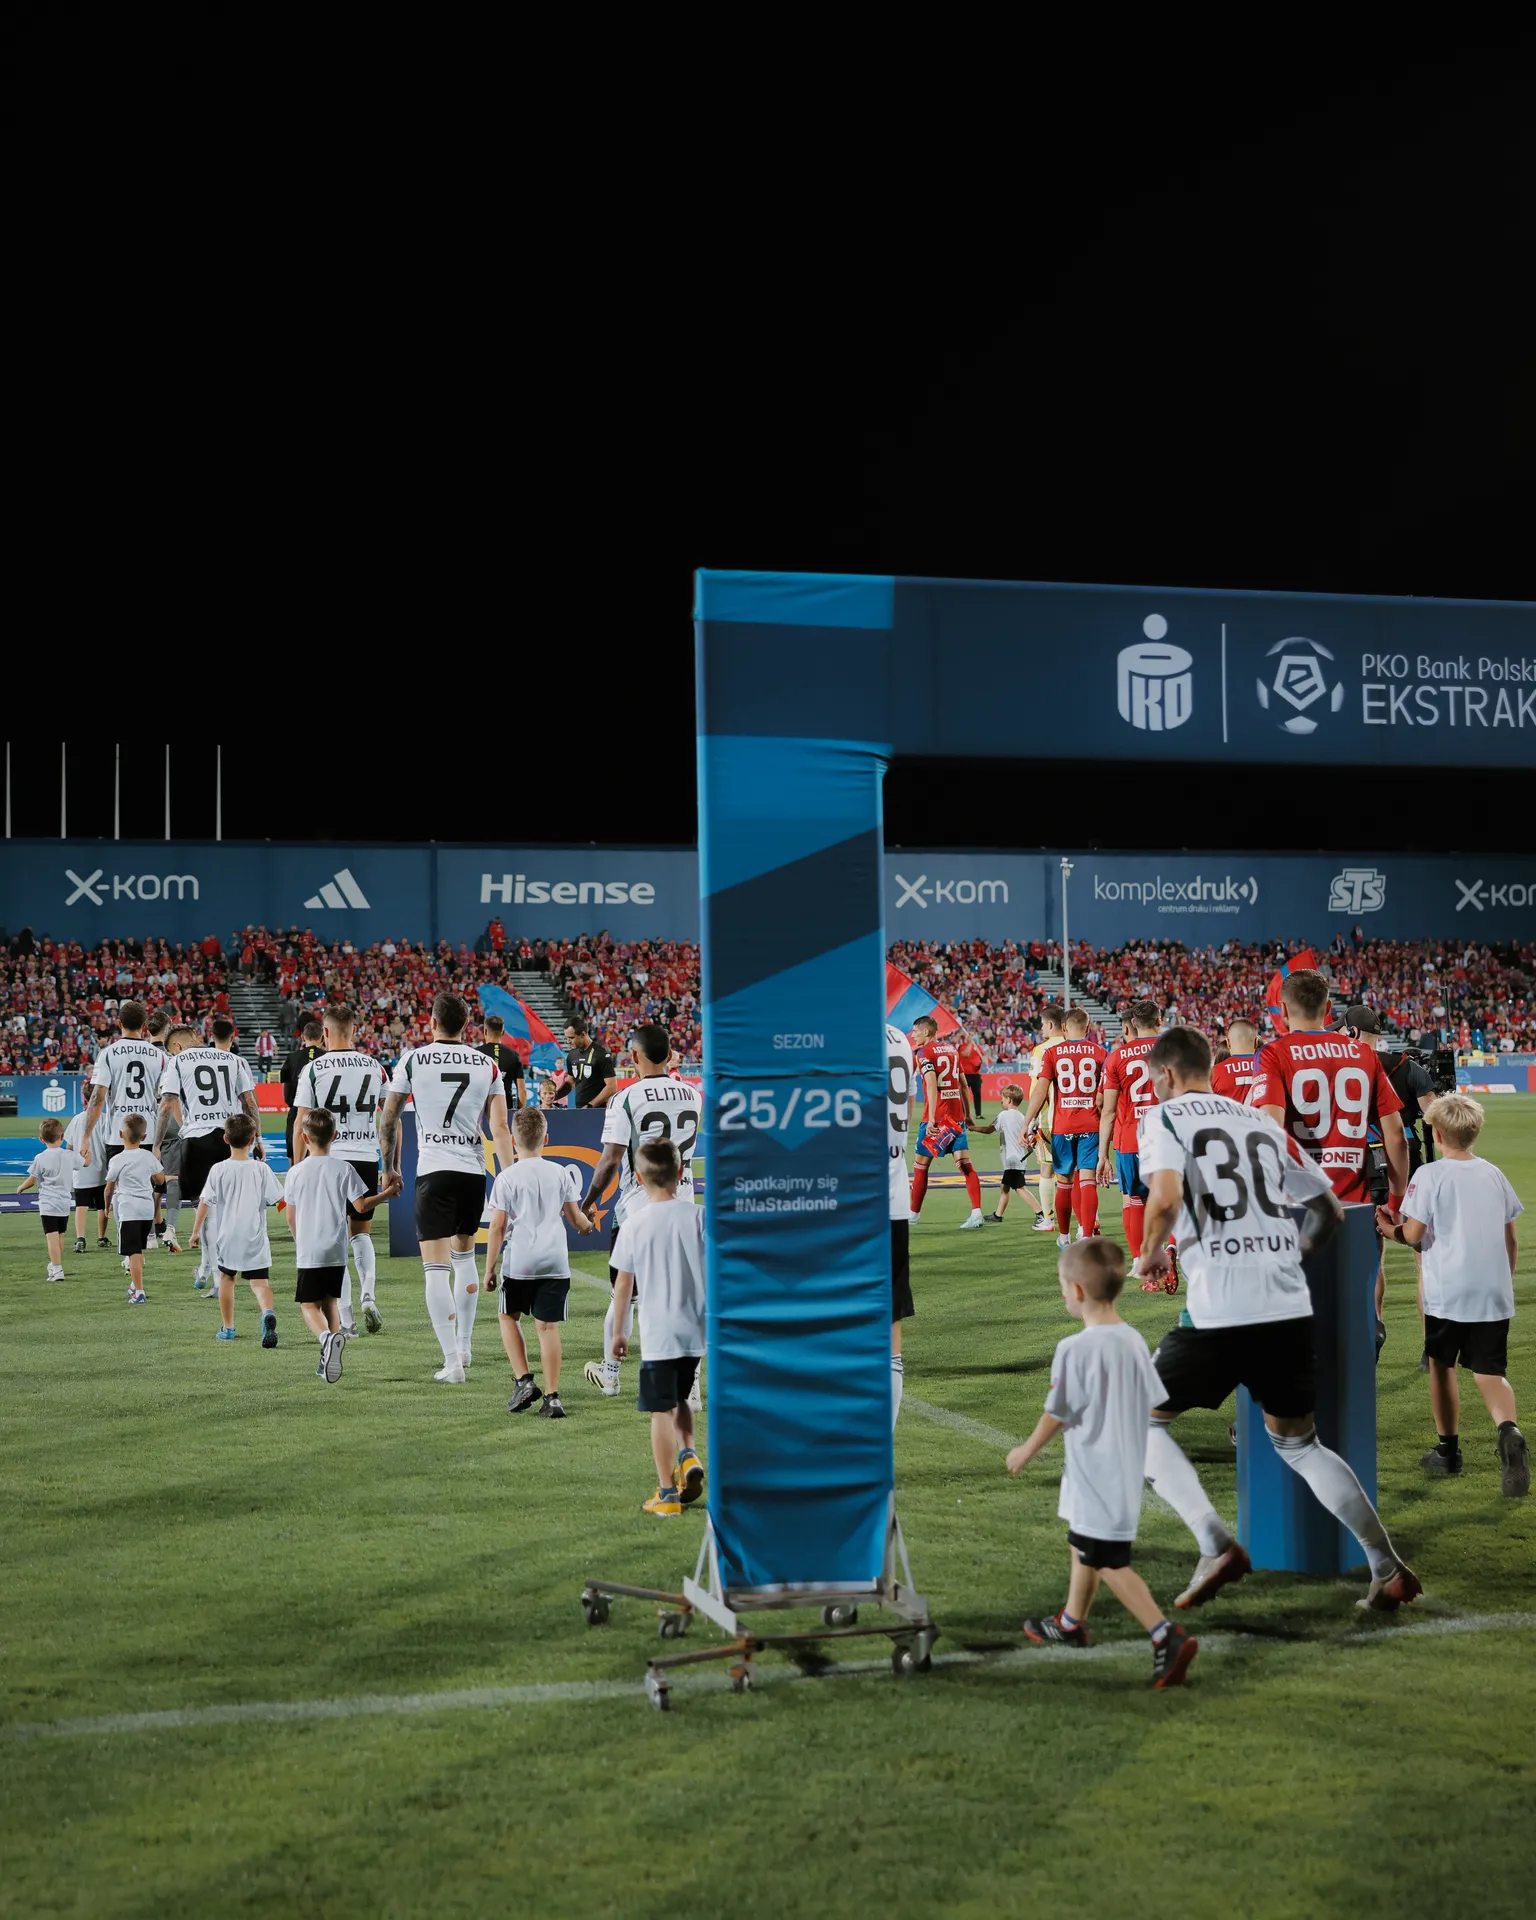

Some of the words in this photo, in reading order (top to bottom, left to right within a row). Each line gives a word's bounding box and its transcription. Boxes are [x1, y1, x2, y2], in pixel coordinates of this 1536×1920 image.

[1361, 653, 1409, 678] PKO
[1416, 655, 1471, 680] Bank
[1478, 657, 1536, 682] Polski
[1362, 683, 1536, 728] EKSTRAK
[480, 873, 656, 905] Hisense
[1094, 874, 1241, 906] komplexdruk
[1328, 868, 1386, 914] STS
[1158, 905, 1187, 913] centrum
[773, 1033, 824, 1049] SEZON
[1056, 1045, 1095, 1055] BARÁTH
[417, 1052, 490, 1066] WSZOŁEK
[1056, 1057, 1097, 1094] 88
[125, 1060, 145, 1099] 3
[194, 1065, 233, 1106] 91
[1126, 1060, 1157, 1102] 2
[324, 1074, 376, 1123] 44
[440, 1073, 470, 1128] 7
[719, 1088, 862, 1130] 25/26
[1291, 1067, 1370, 1140] 99
[425, 1134, 482, 1146] FORTUNA
[734, 1175, 814, 1193] Spotkajmy
[817, 1174, 839, 1192] się
[1192, 1127, 1291, 1222] 30
[735, 1197, 838, 1213] #NaStadionie
[1210, 1235, 1295, 1257] FORTUN
